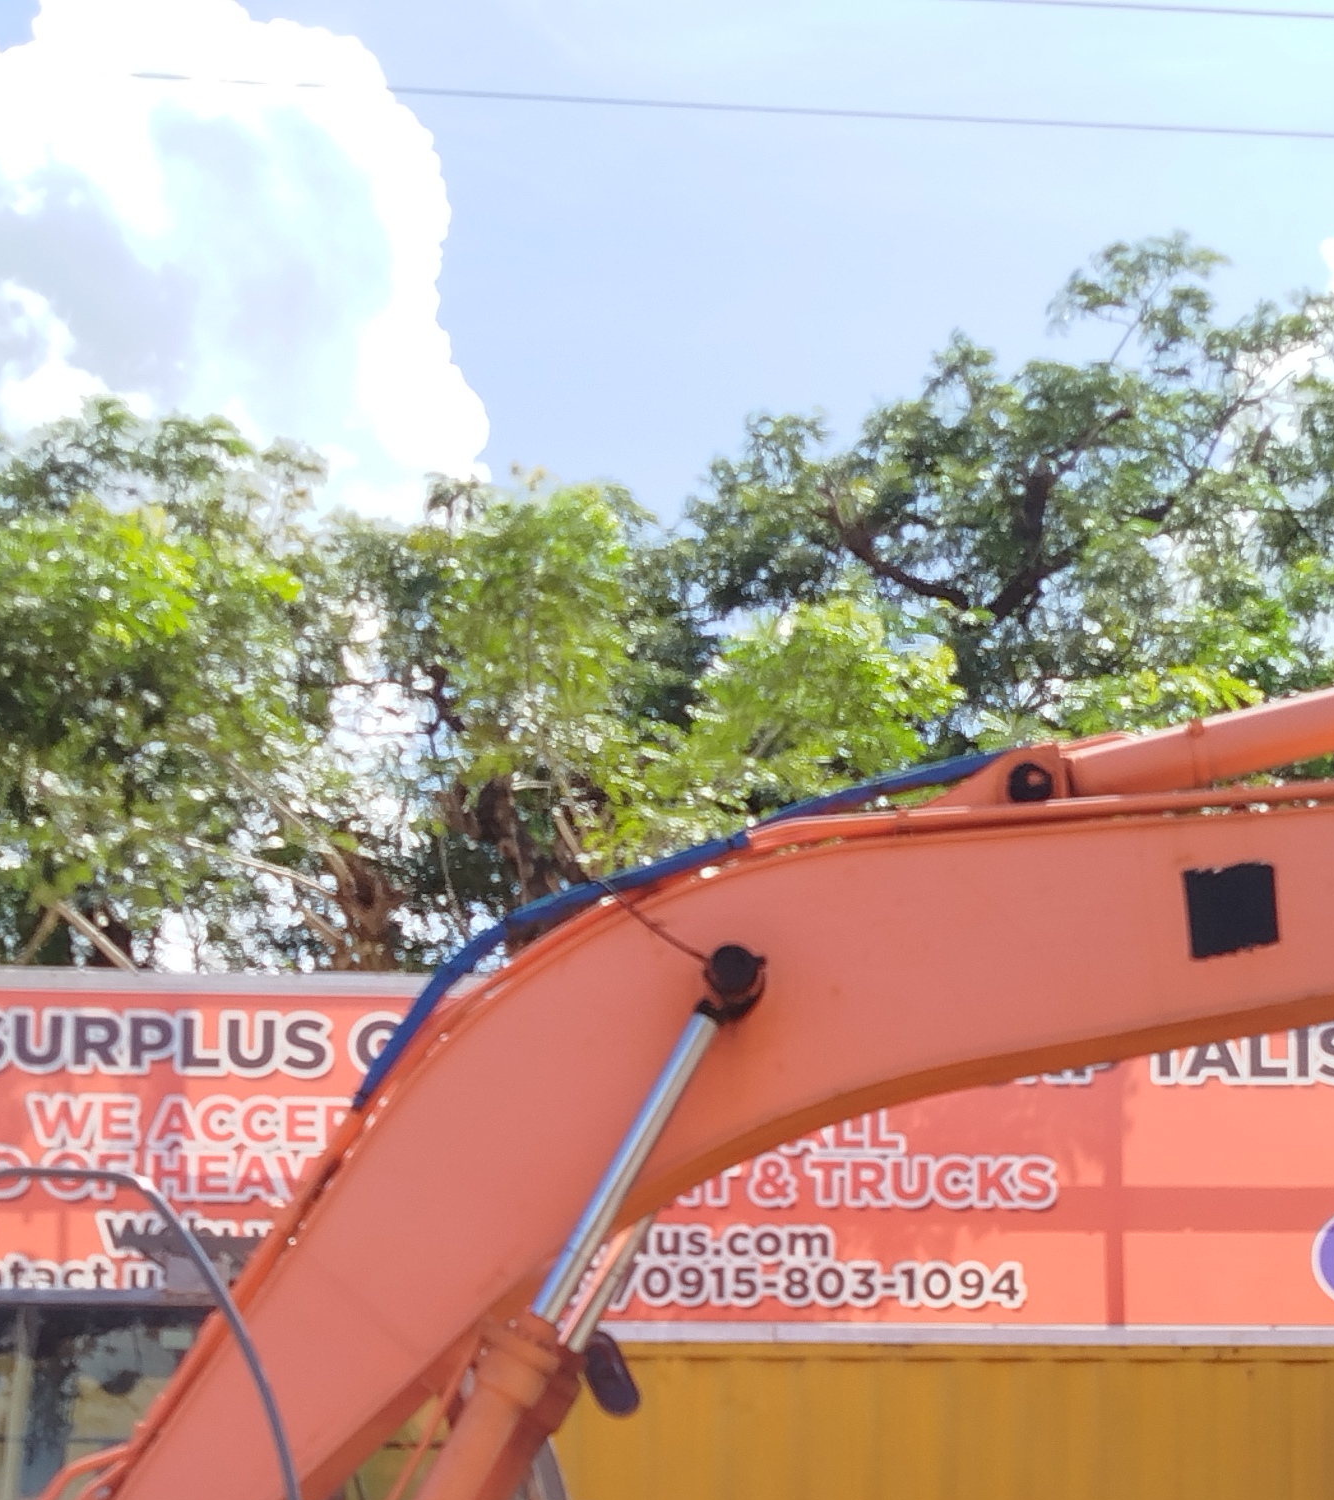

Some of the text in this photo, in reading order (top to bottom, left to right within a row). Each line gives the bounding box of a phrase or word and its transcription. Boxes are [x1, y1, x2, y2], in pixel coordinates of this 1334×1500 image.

[33, 1100, 350, 1143] WE ACCEP
[48, 1151, 135, 1192] OF
[155, 1153, 313, 1194] HEAV
[754, 1160, 792, 1200] &
[810, 1160, 1053, 1206] TRUCKS
